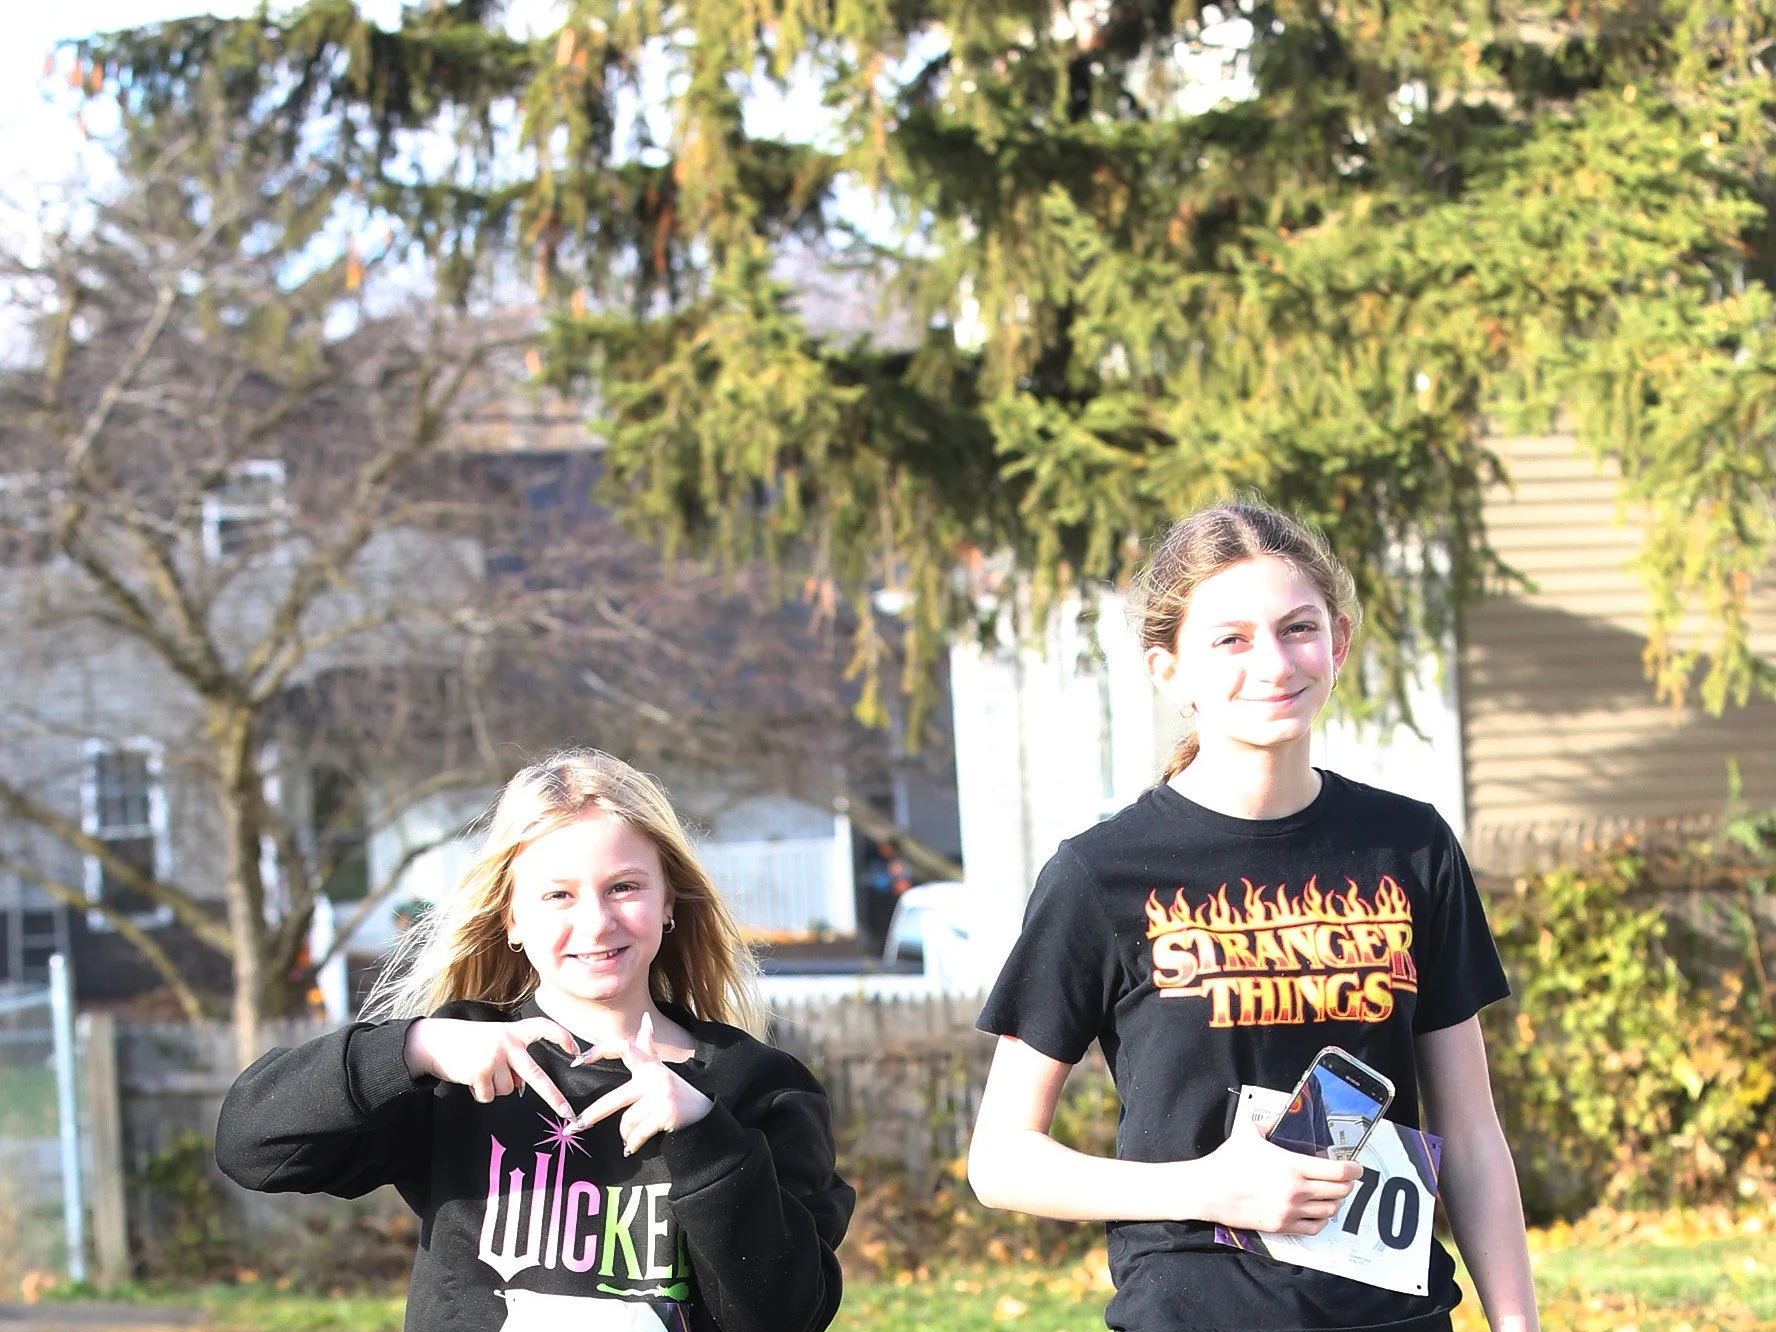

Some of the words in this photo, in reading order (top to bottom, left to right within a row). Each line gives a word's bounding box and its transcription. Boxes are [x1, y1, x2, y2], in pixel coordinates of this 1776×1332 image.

[1152, 922, 1418, 988] STRANGER
[1202, 970, 1394, 1028] THINGS
[1340, 1166, 1420, 1250] 70
